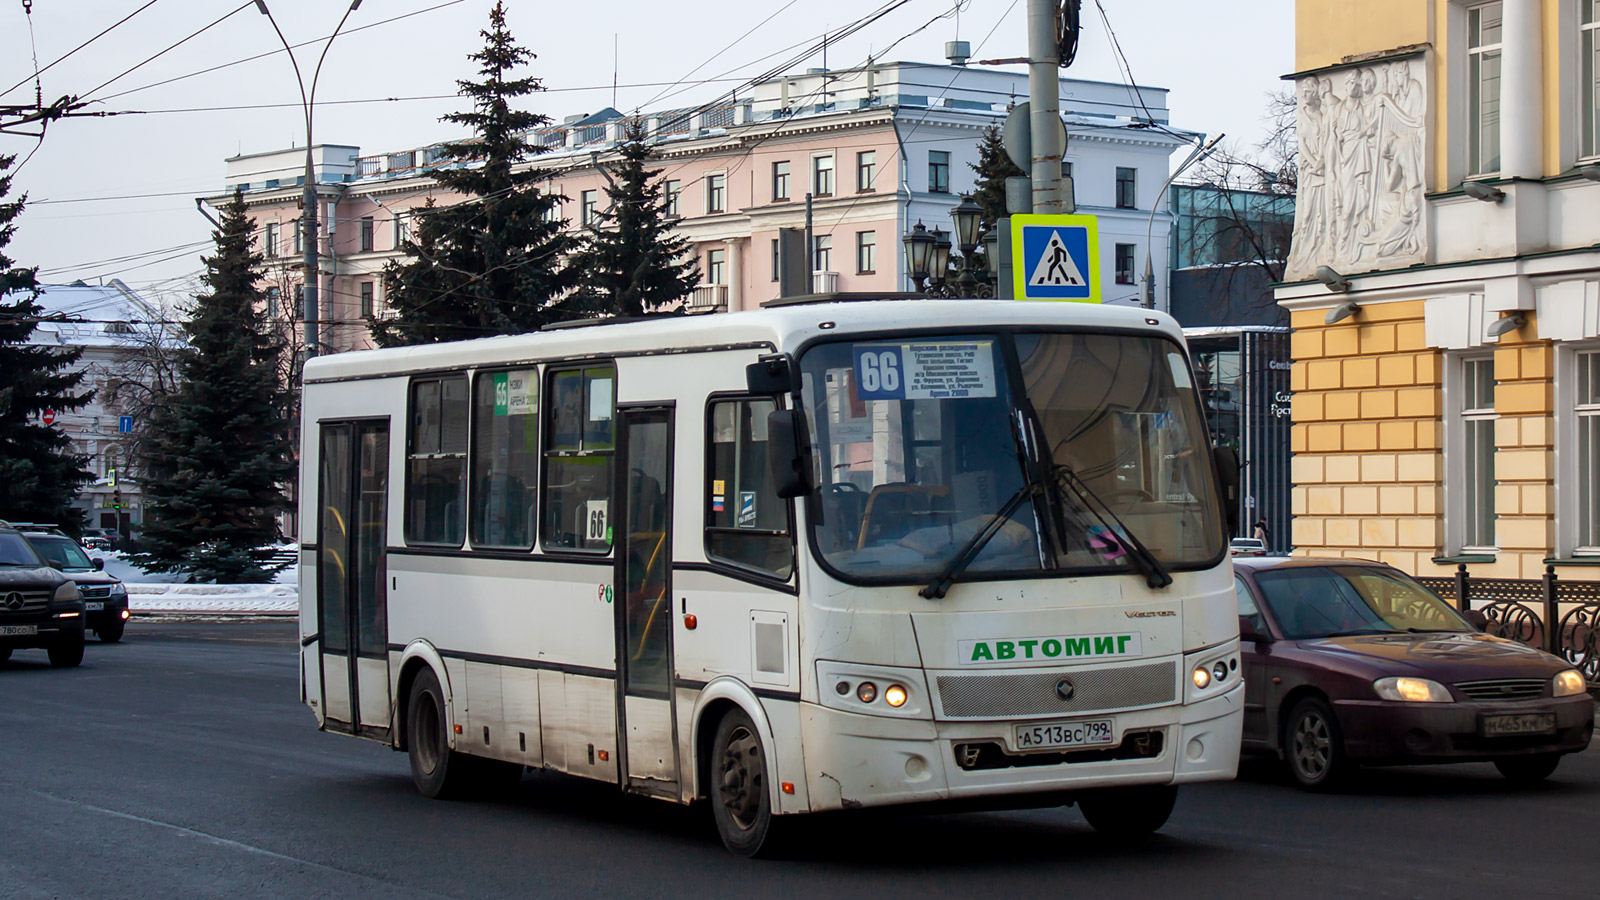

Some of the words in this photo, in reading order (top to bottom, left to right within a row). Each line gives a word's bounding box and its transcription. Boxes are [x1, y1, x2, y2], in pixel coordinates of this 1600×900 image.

[860, 352, 899, 392] 66
[496, 382, 507, 406] 66
[590, 510, 604, 538] 66
[971, 636, 1132, 661] АВТОМИГ
[1023, 726, 1083, 745] А513ВС
[1085, 722, 1107, 737] 799
